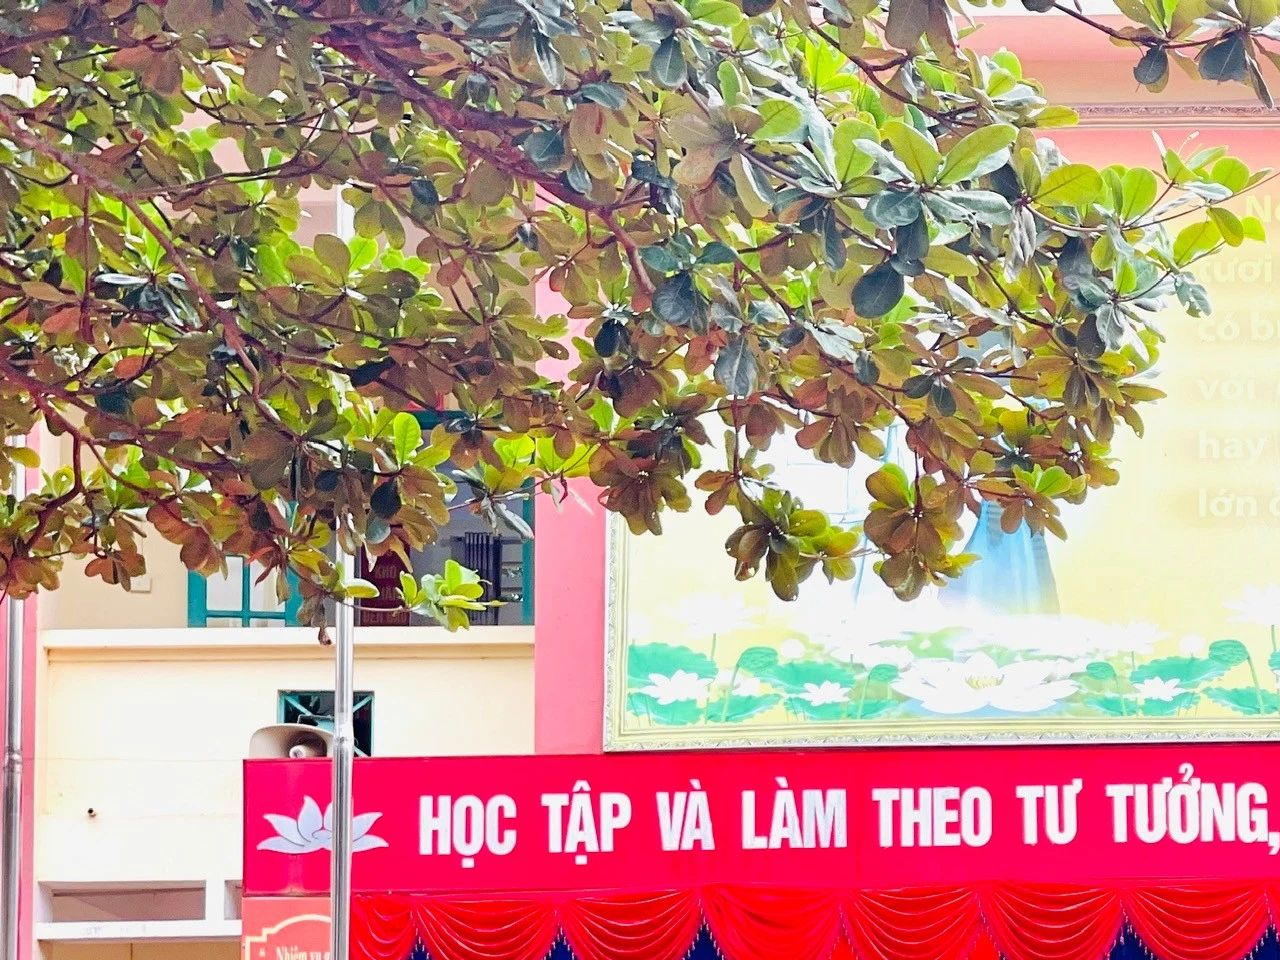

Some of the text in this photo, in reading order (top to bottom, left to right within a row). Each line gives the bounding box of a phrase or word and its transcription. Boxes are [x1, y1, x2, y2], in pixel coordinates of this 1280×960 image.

[418, 793, 517, 869] HỌC
[541, 780, 632, 866] TẬP
[656, 778, 716, 852] VÀ
[741, 776, 848, 851] LÀM
[872, 786, 993, 849] THEO
[1017, 778, 1082, 844] TƯ
